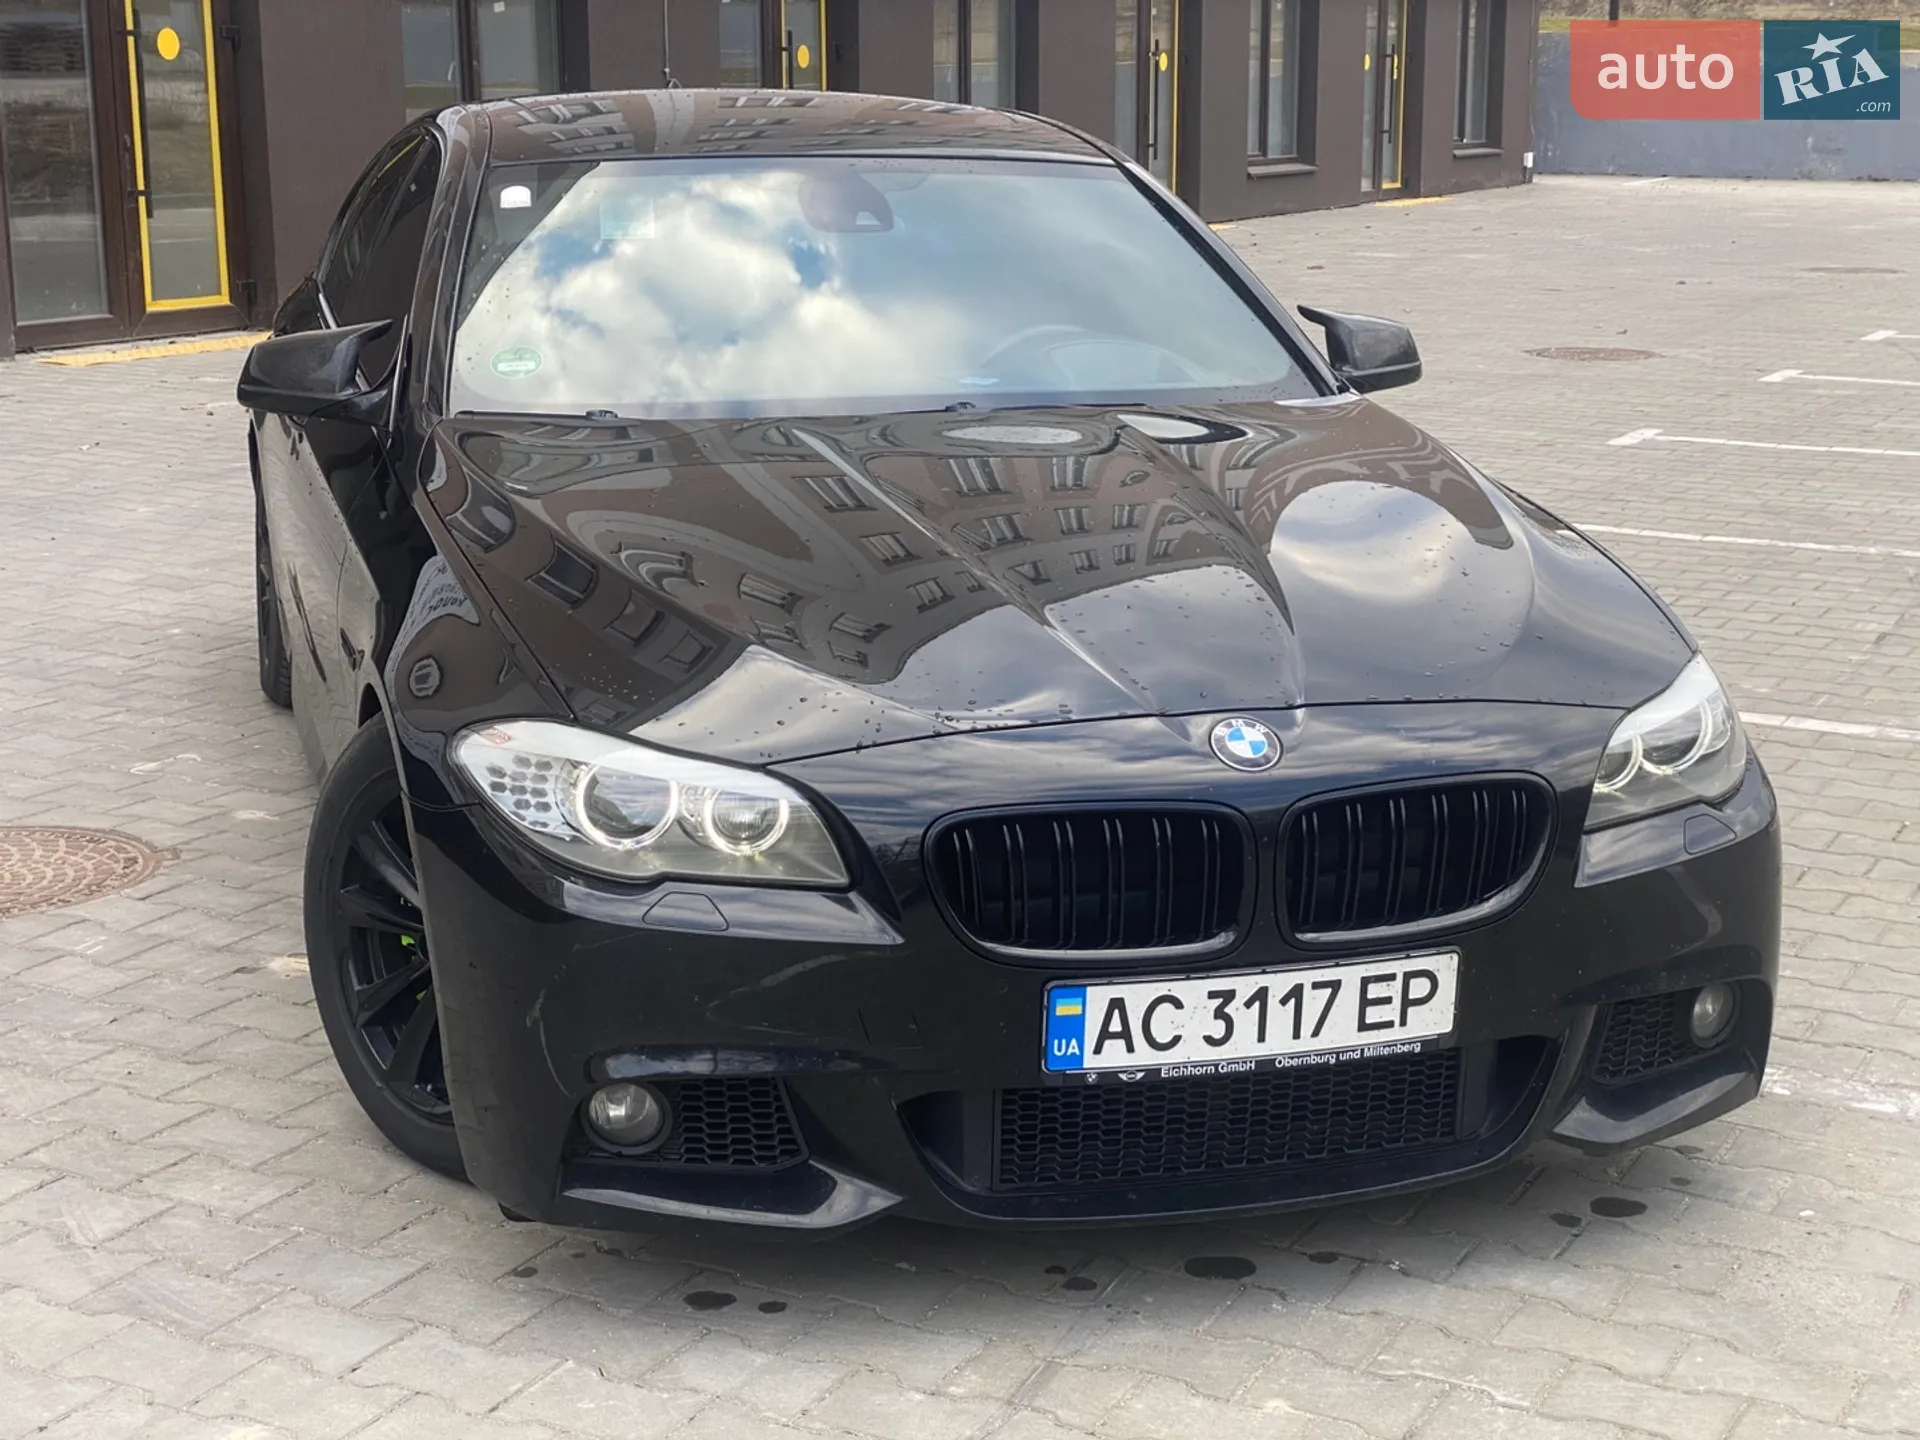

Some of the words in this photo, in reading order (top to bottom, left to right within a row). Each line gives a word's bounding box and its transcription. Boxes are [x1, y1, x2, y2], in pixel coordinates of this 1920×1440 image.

[1092, 995, 1185, 1056] AC
[1202, 979, 1343, 1048] 3117
[1356, 968, 1440, 1034] EP
[1053, 1037, 1081, 1057] UA
[1160, 1064, 1216, 1078] Eichhorn
[1217, 1060, 1256, 1074] GmbH
[1274, 1053, 1337, 1068] Obernburg
[1339, 1048, 1361, 1060] und
[1363, 1041, 1422, 1057] Miltenberg
